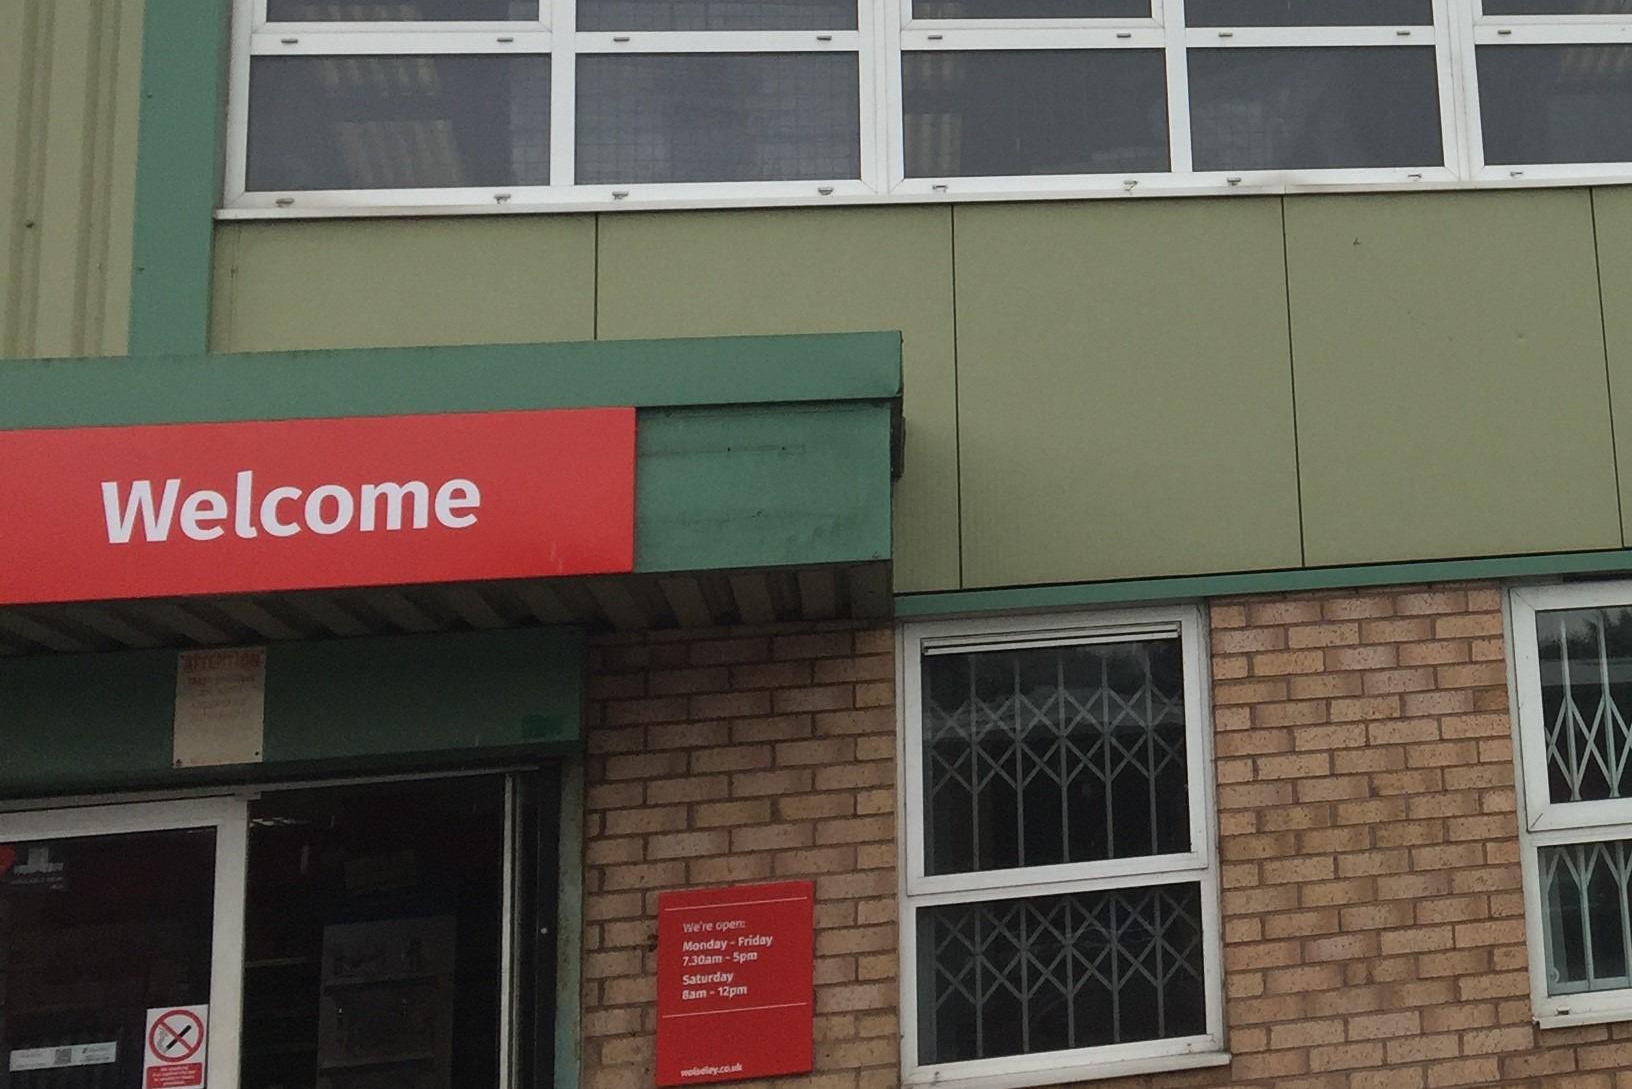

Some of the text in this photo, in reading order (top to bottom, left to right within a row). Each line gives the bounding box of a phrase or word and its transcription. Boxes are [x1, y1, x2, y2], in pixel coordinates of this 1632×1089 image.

[101, 470, 482, 544] Welcome
[682, 921, 714, 933] We're
[682, 939, 728, 952] Monday
[738, 934, 773, 947] Friday
[682, 954, 722, 967] 7.30am
[732, 952, 758, 964] 5pm
[682, 972, 734, 985] Saturday
[682, 988, 707, 1000] 8am
[718, 985, 748, 998] 12pm
